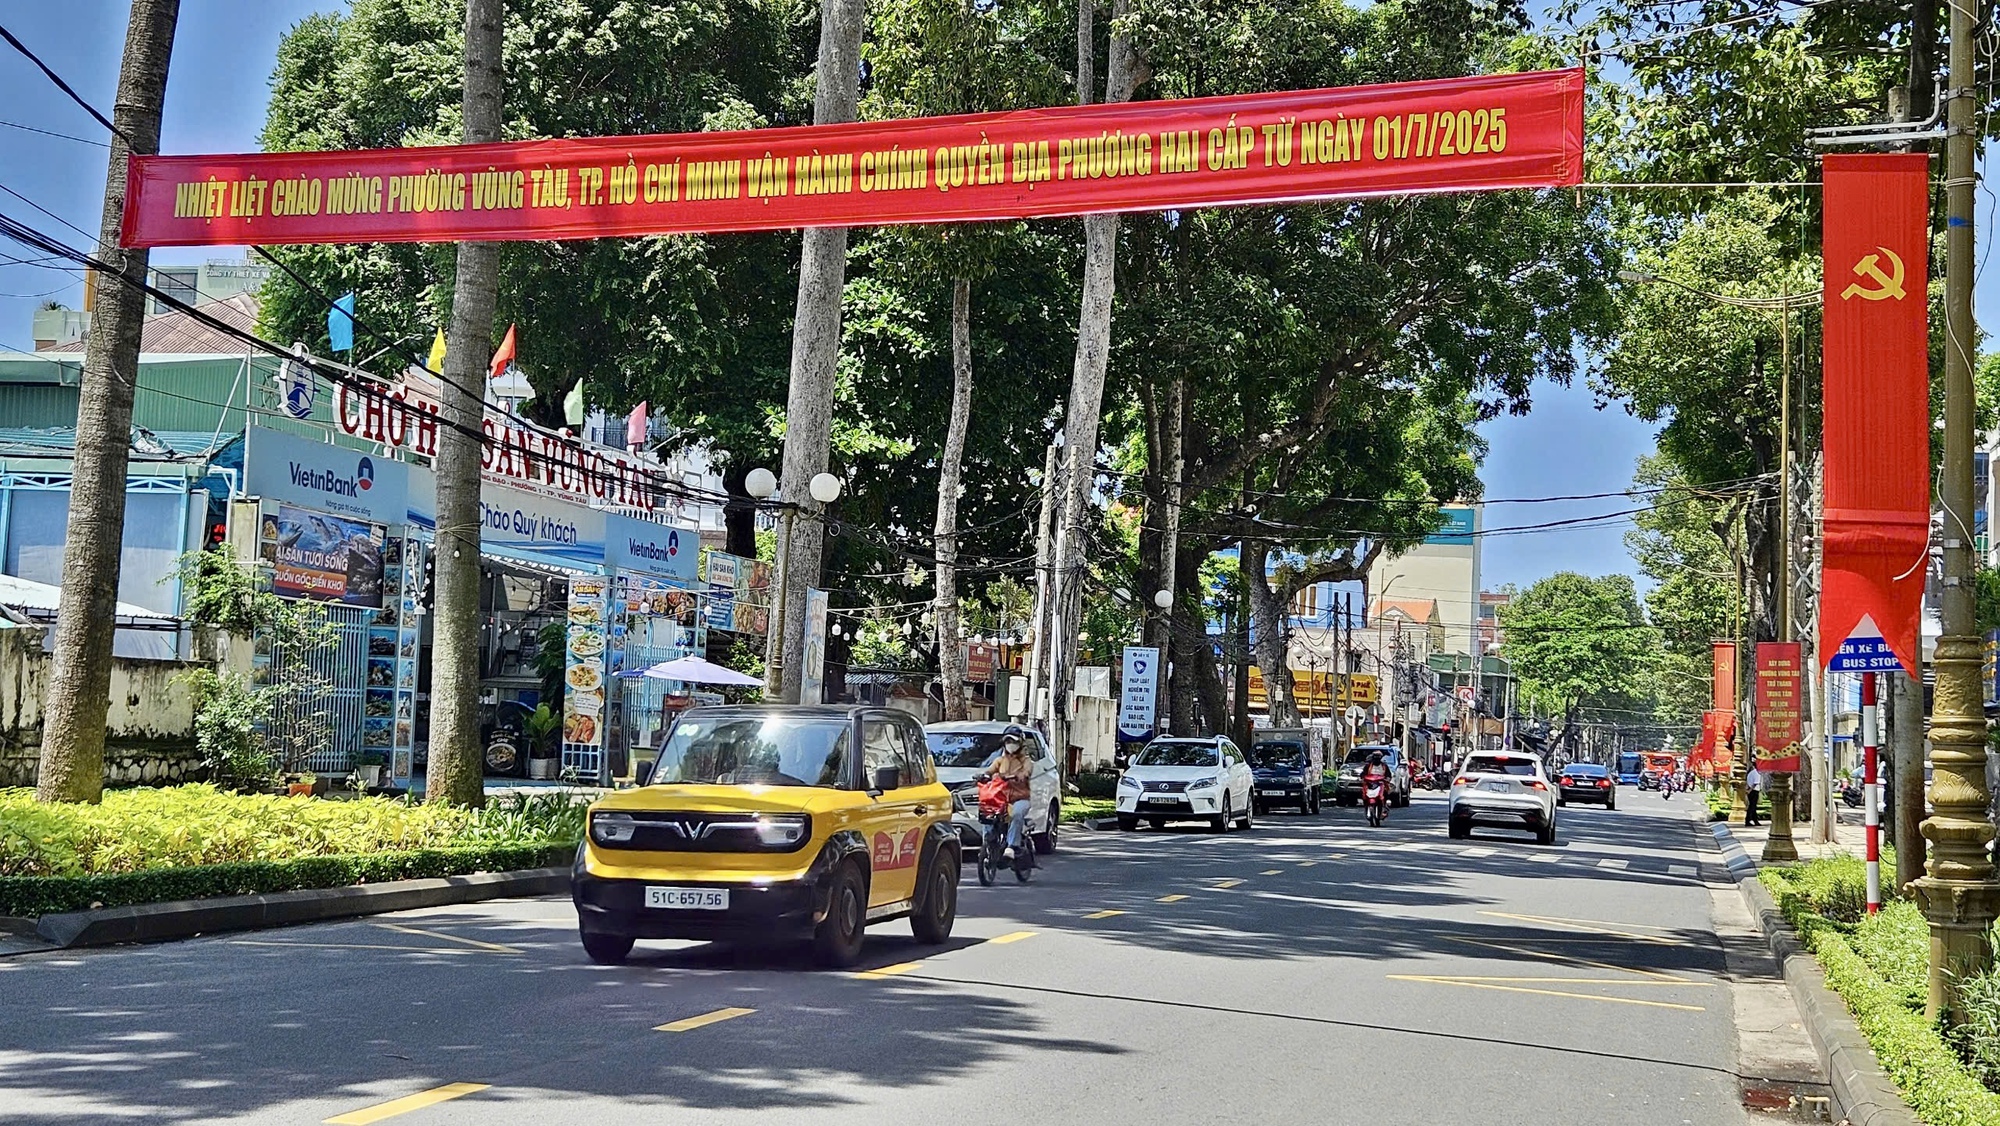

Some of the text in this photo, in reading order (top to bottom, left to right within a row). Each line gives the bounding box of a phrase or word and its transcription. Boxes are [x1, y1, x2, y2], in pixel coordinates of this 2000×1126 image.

[174, 108, 1507, 224] NHIỆT LIỆT CHÀO MỪNG PHƯỜNG VŨNG TÀU, TP. HỒ CHÍ MINH VẬN HÀNH CHÍNH QUYỀN ĐỊA PHƯƠNG HAI CẤP TỪ NGÀY 01/7/2025
[289, 461, 358, 498] VietinBank
[513, 510, 538, 542] Quý
[541, 516, 577, 546] khách
[275, 542, 348, 571] ẢI SẢN TƯƠI SỐNG
[629, 537, 669, 562] VietinBank
[327, 575, 344, 591] KHƠI
[1836, 641, 1892, 654] ẾN XE BU
[1843, 657, 1900, 668] BUS STOP
[652, 891, 722, 906] 51C-657.56
